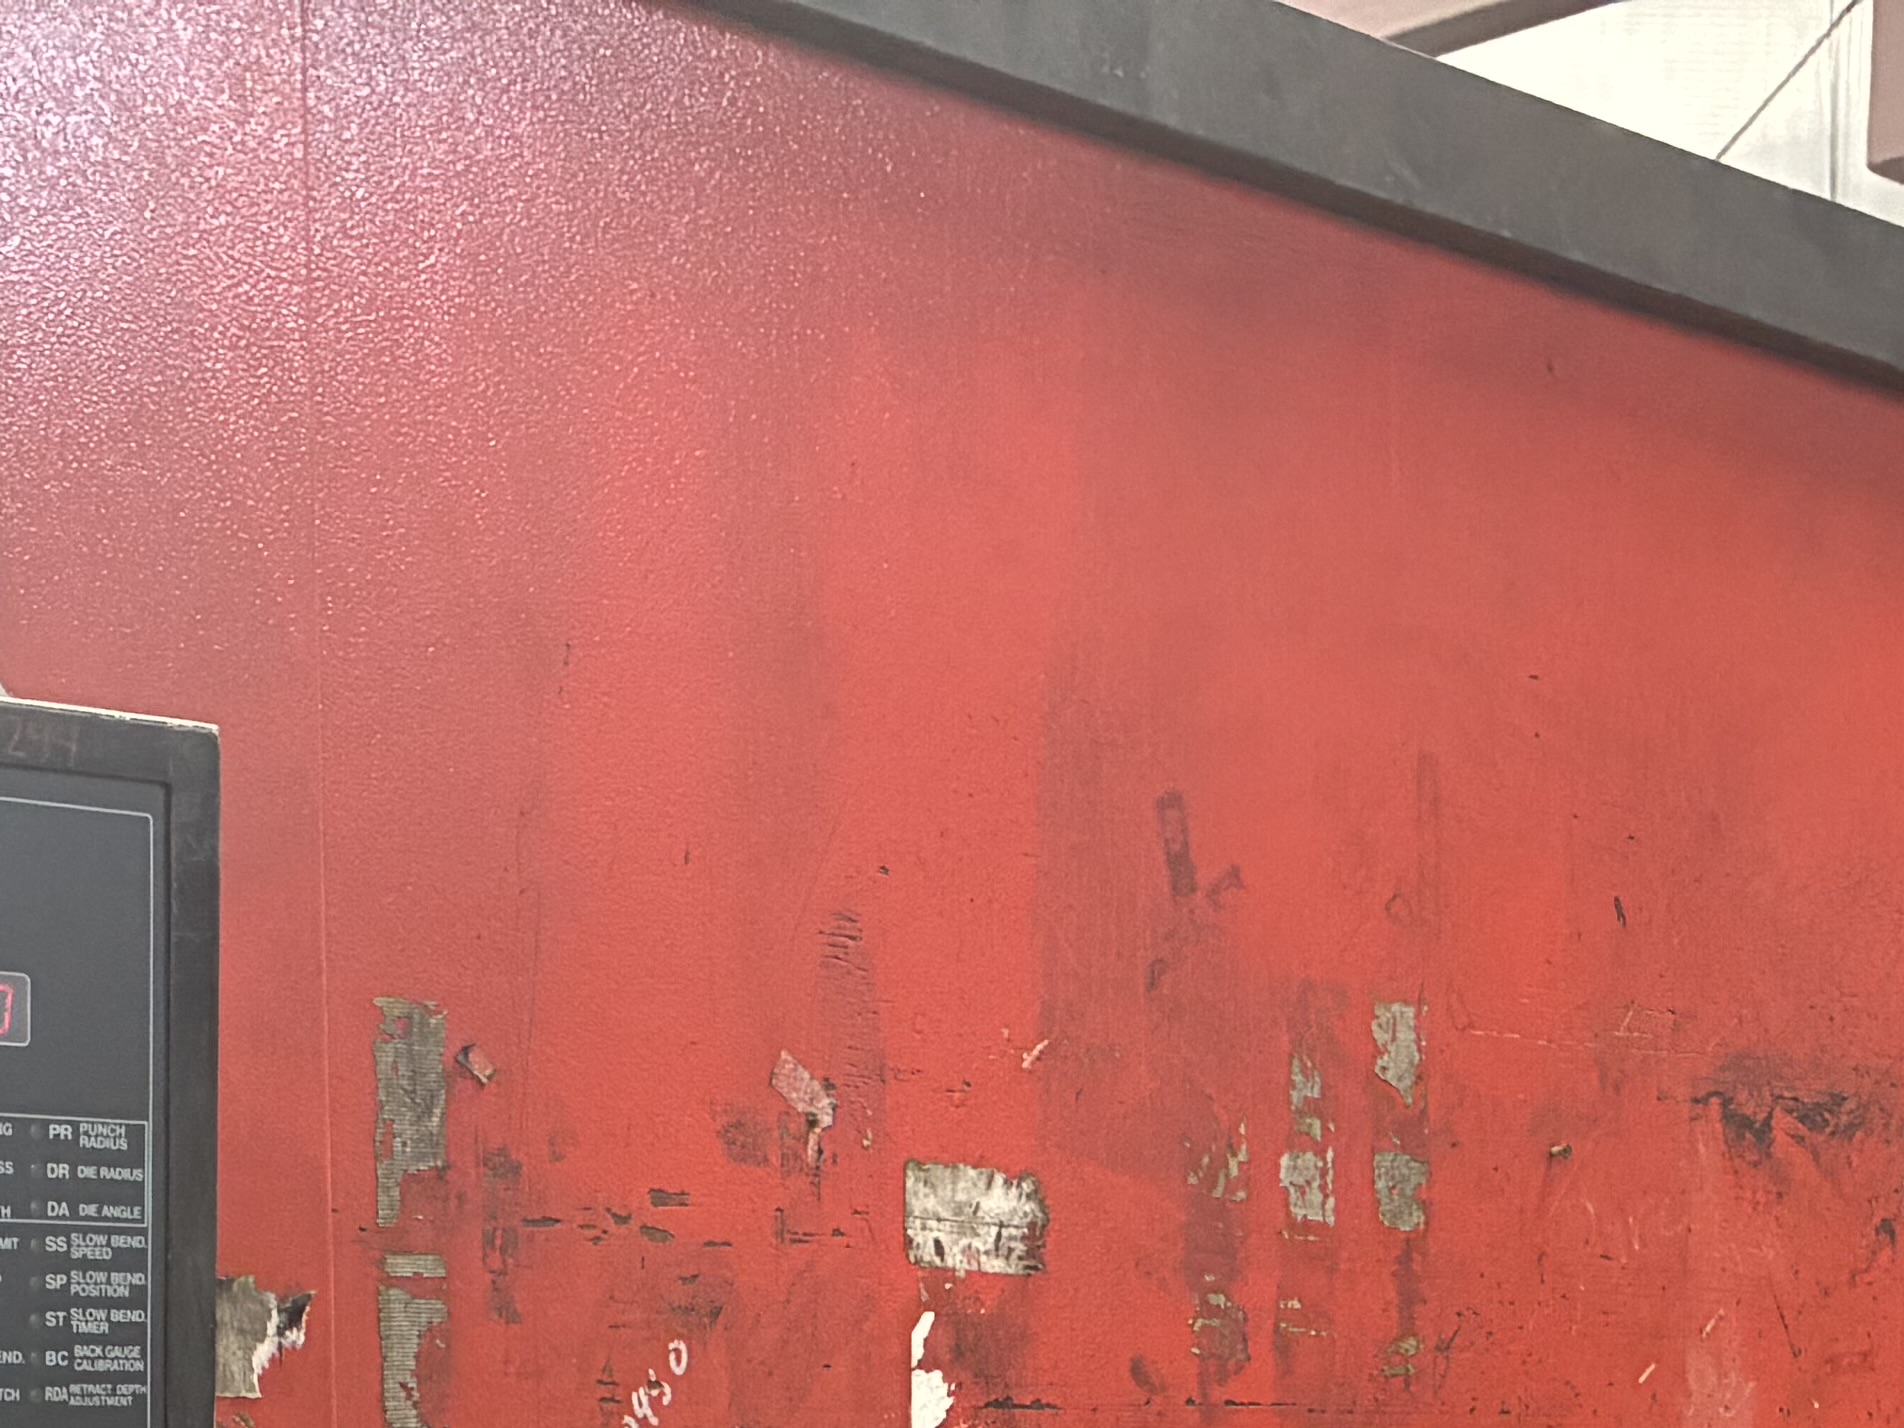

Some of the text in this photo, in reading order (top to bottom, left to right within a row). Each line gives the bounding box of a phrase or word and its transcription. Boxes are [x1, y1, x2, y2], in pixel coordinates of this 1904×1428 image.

[49, 1124, 73, 1141] PR
[79, 1123, 126, 1138] PUNCH
[79, 1135, 128, 1150] RADIUS
[100, 1166, 144, 1182] RADIUS
[102, 1204, 142, 1219] ANGLE
[70, 1284, 129, 1298] POSITION
[46, 1351, 68, 1366] BC
[74, 1358, 144, 1372] CALIBRATION
